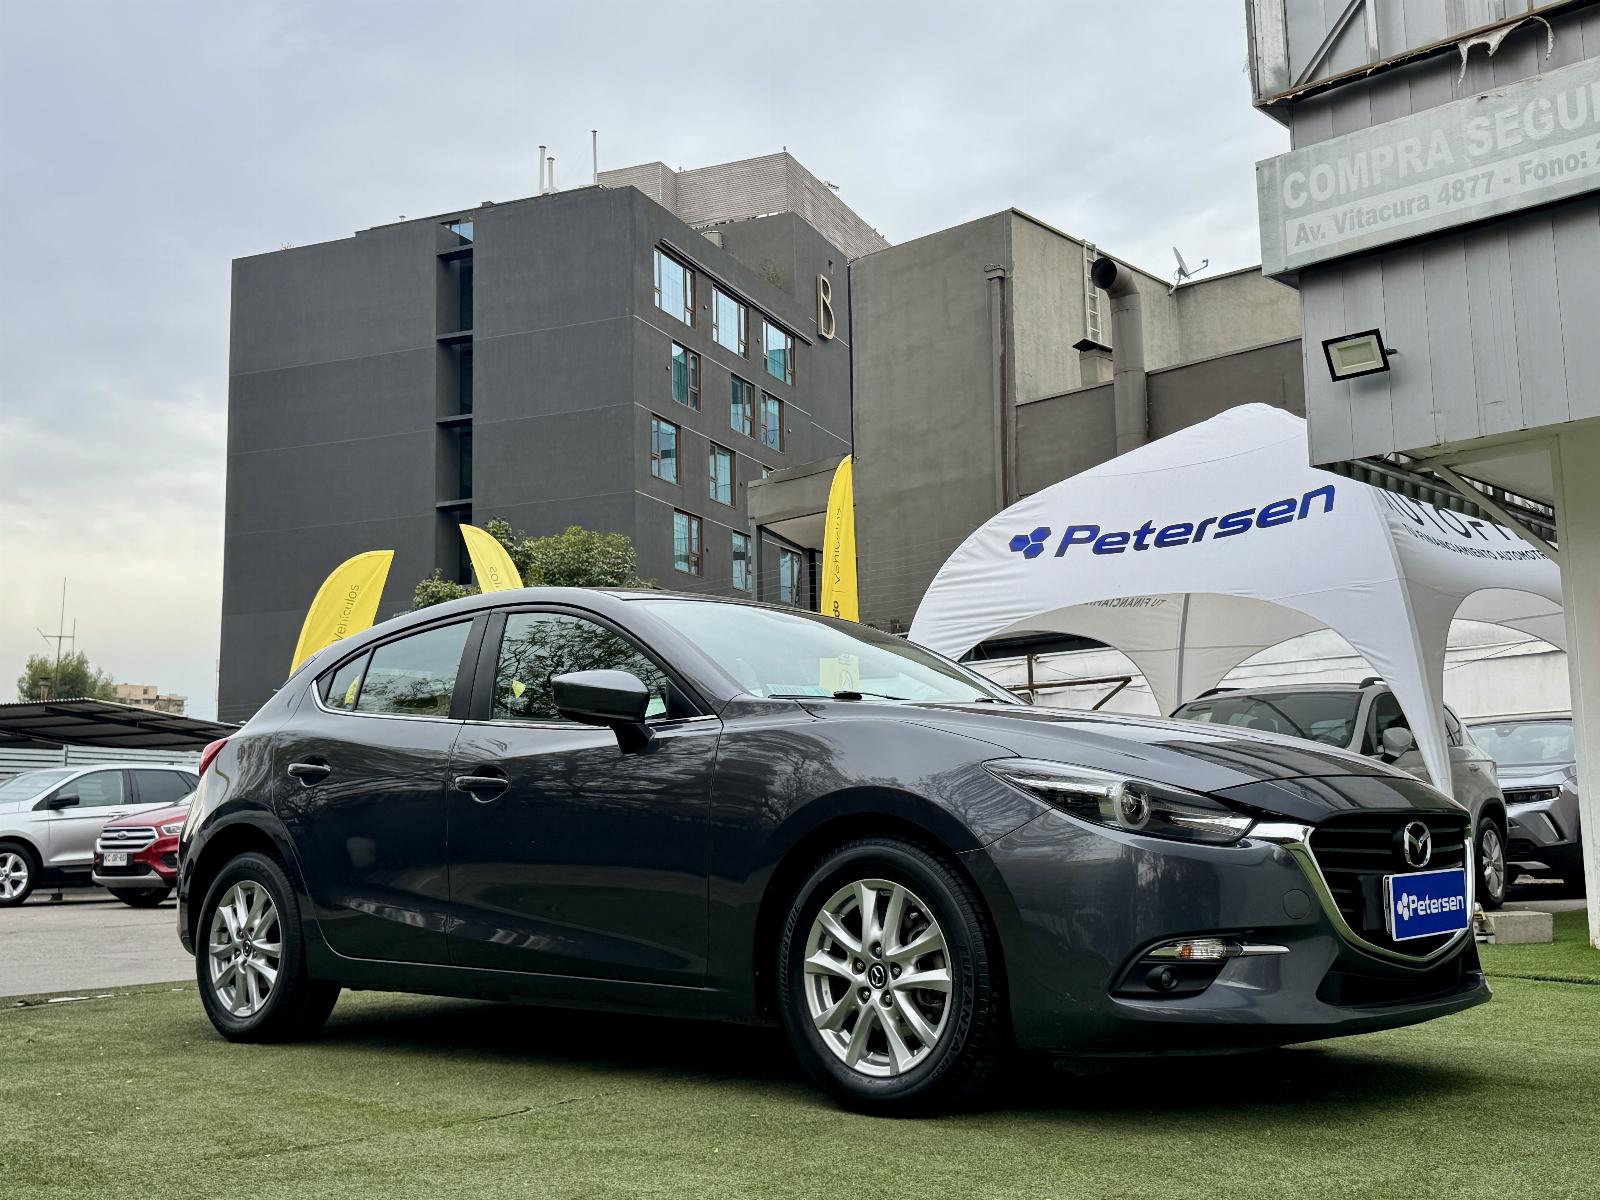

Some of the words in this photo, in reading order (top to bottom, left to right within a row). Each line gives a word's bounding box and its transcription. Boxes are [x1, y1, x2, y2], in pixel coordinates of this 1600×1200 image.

[1283, 129, 1455, 209] COMPRA
[1294, 222, 1326, 247] Av.
[1332, 193, 1430, 235] Vitacura
[1437, 170, 1496, 206] 4877
[1519, 150, 1587, 185] Fono:
[1054, 484, 1336, 558] Petersen
[1495, 549, 1549, 561] AUTOMOTR
[1408, 894, 1465, 917] Petersen
